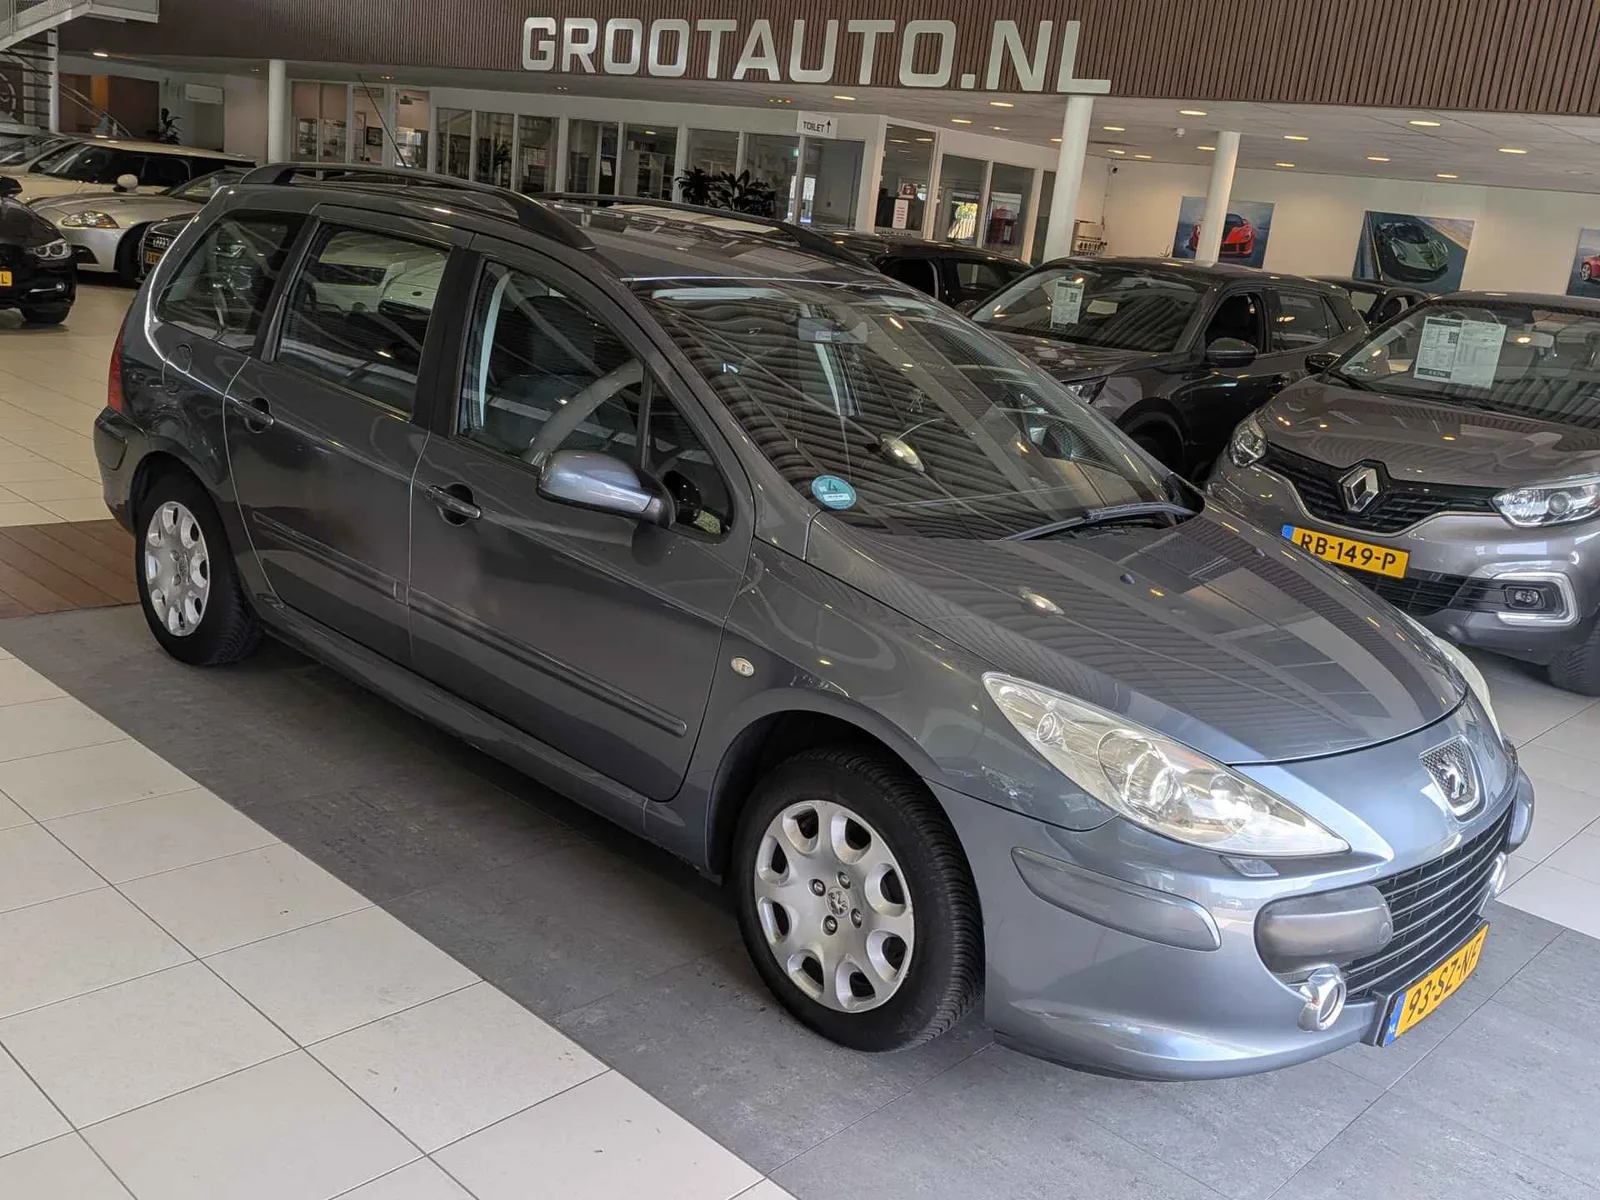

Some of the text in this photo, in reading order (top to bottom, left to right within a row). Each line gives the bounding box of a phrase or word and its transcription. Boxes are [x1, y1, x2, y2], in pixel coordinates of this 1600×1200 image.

[522, 16, 1111, 94] GROOTAUTO.NL
[803, 120, 825, 133] TOILET
[1300, 532, 1397, 571] RB-149-P
